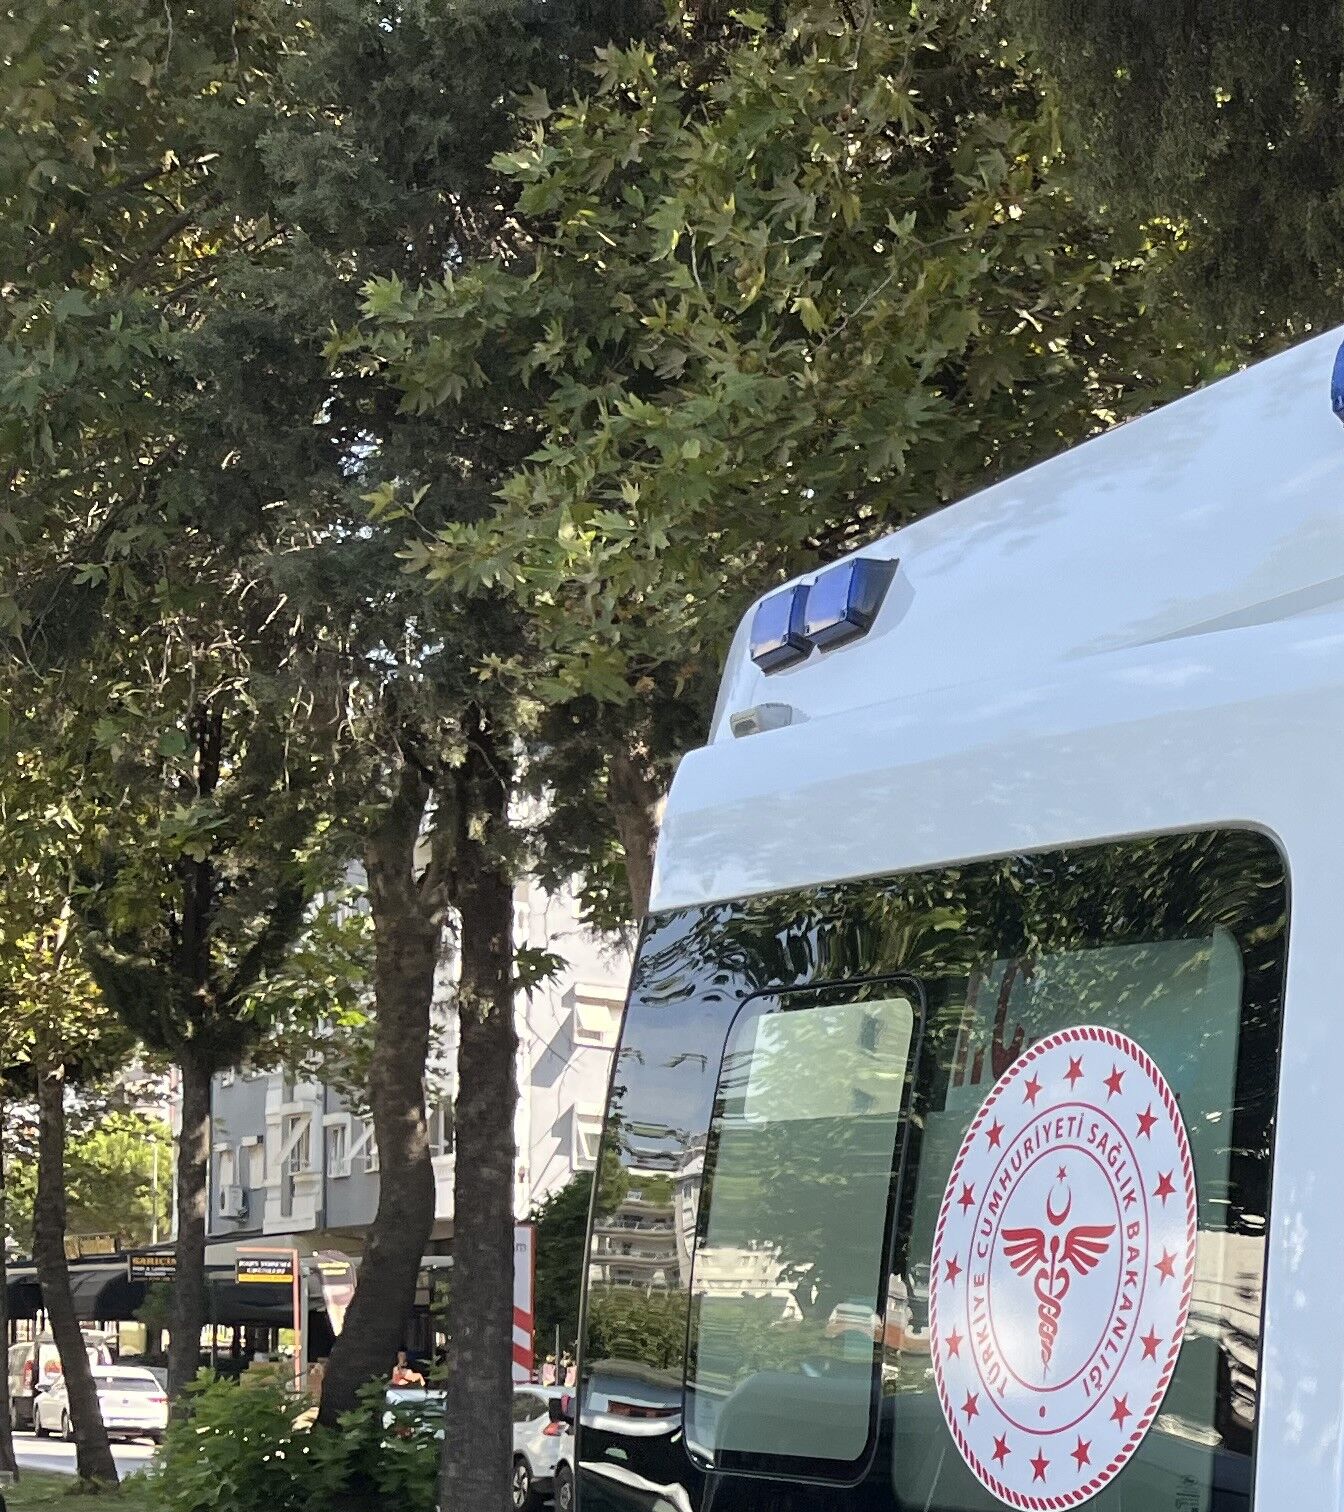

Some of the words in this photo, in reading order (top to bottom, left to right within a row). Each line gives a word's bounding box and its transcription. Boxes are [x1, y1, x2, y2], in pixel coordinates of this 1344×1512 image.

[977, 1112, 1085, 1258] CUMHURİYETİ
[1087, 1122, 1138, 1212] SAĞLIK
[1082, 1220, 1141, 1398] BAKANLIĞI
